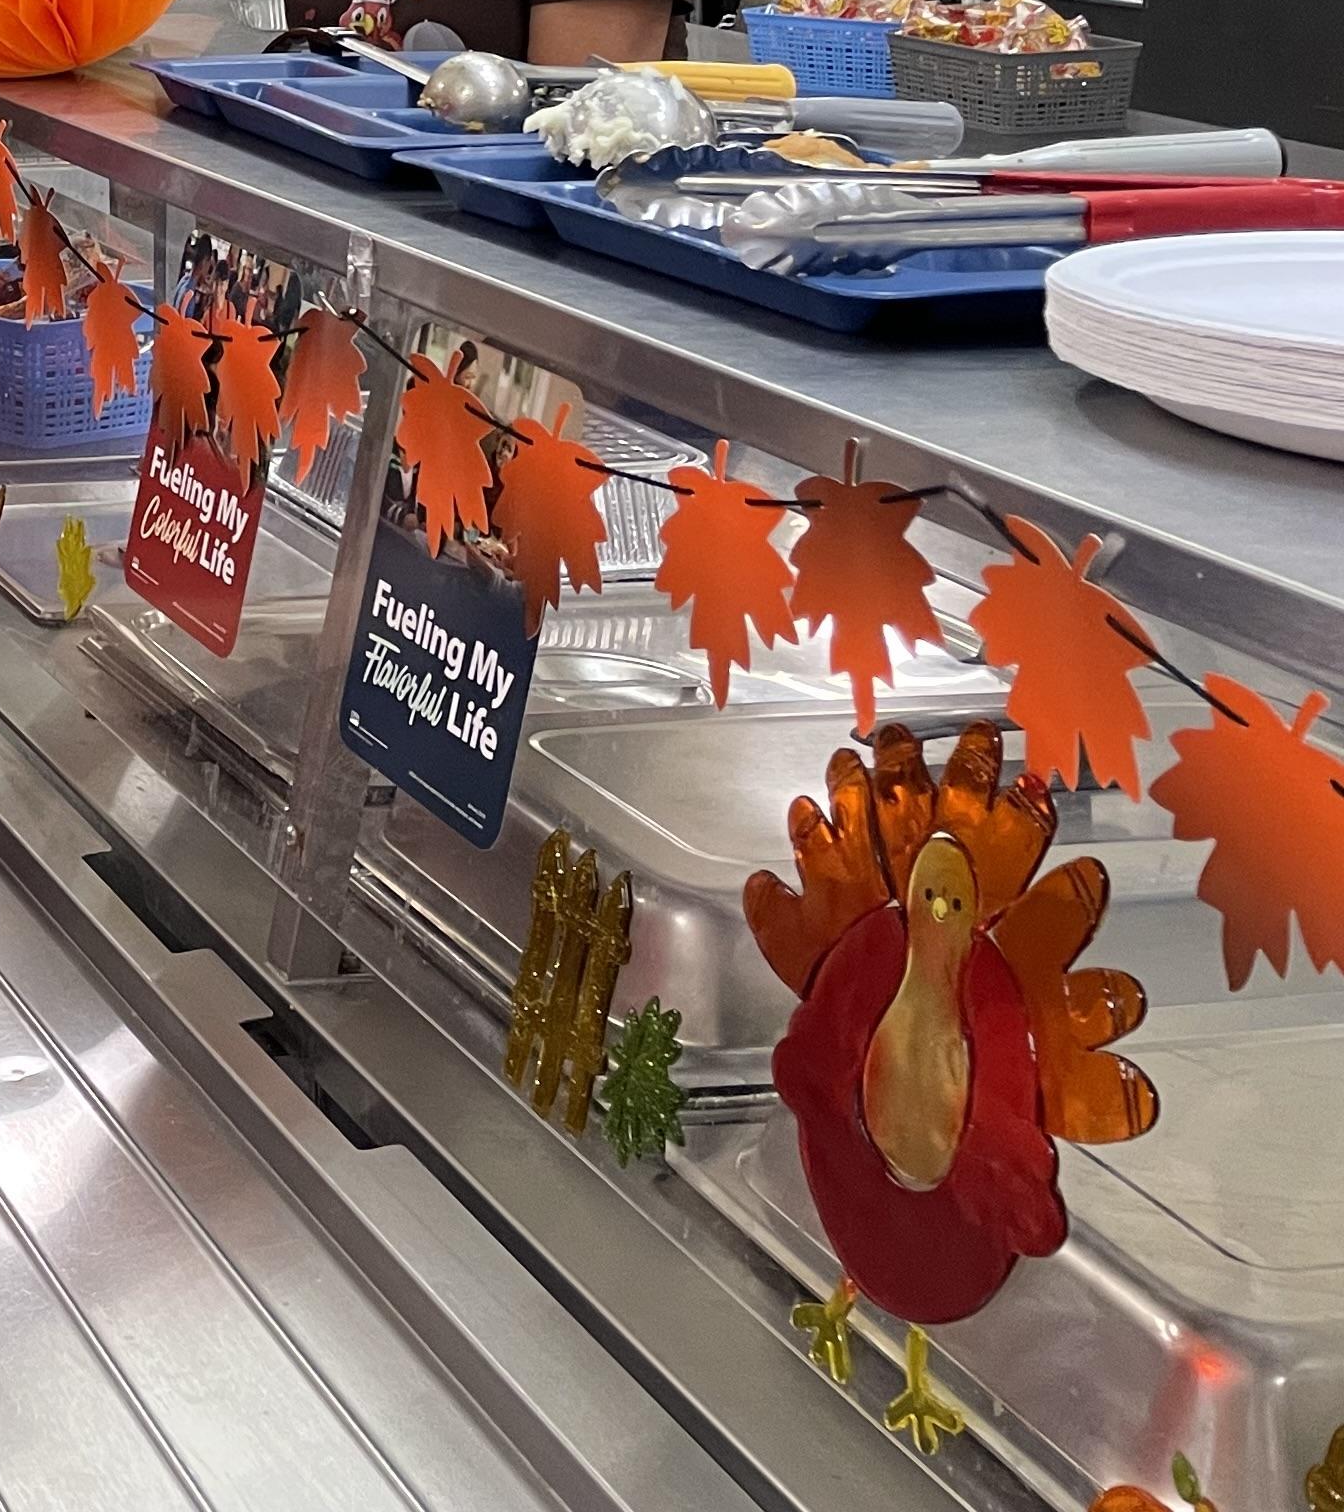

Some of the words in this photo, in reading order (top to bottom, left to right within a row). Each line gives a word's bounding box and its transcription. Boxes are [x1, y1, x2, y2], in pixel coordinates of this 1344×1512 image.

[140, 495, 202, 564] Colorful
[199, 532, 235, 586] Life
[149, 445, 216, 524] Fueling
[216, 488, 249, 544] My
[362, 632, 447, 727] Flavorful
[446, 691, 499, 761] Life
[372, 578, 466, 681] Fueling
[467, 640, 515, 709] My
